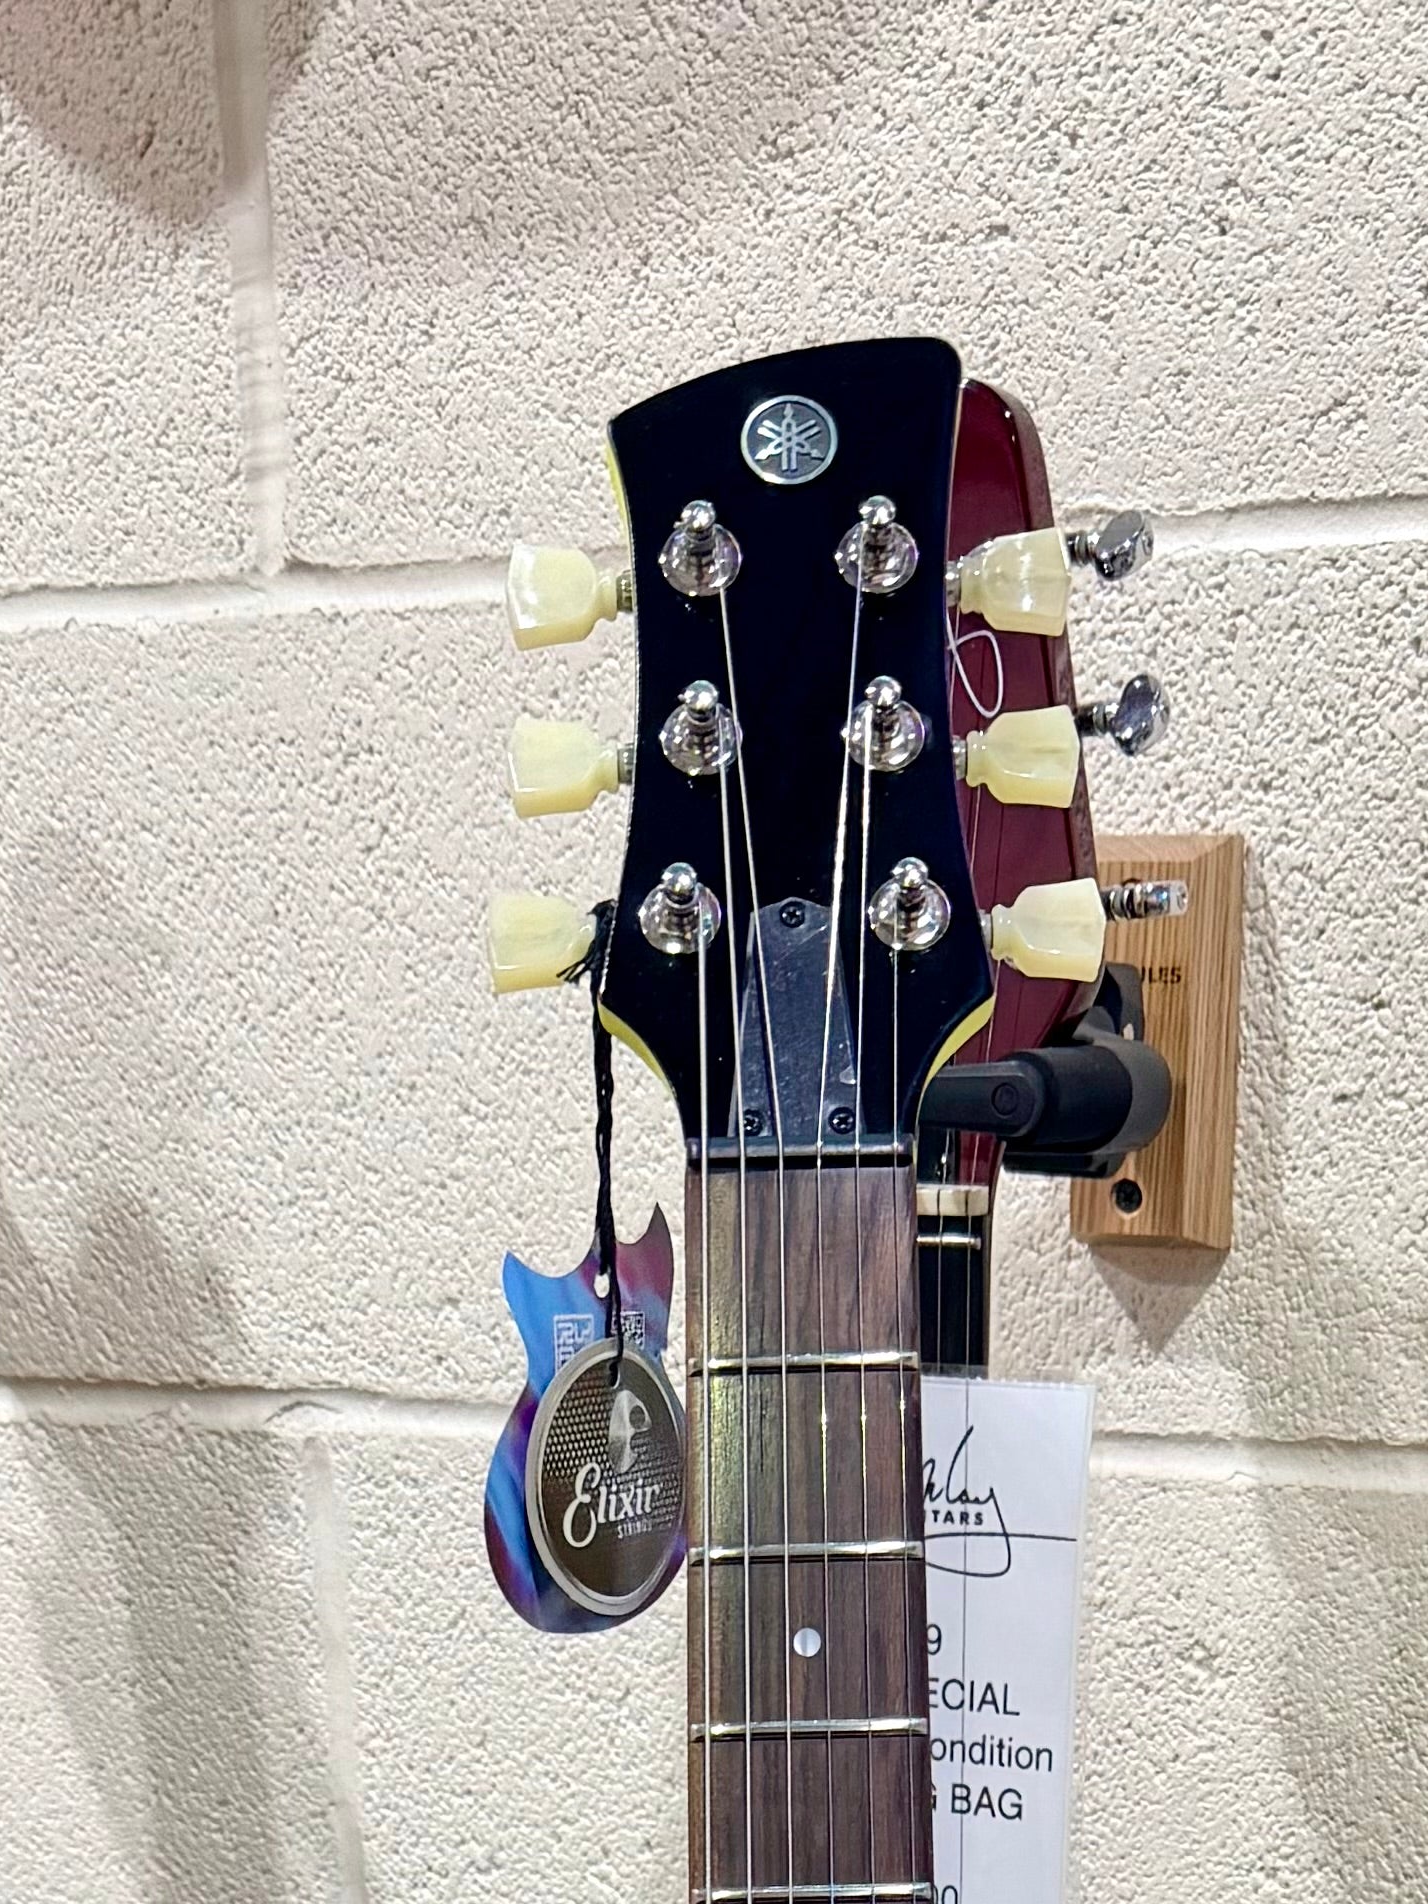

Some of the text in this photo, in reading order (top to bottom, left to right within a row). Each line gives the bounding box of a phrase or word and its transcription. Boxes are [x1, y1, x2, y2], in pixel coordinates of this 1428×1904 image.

[563, 1462, 660, 1548] Elixir
[923, 1509, 984, 1526] TARS
[928, 1677, 1020, 1716] ECIAL
[930, 1734, 1053, 1772] ondition
[951, 1783, 1023, 1821] BAG
